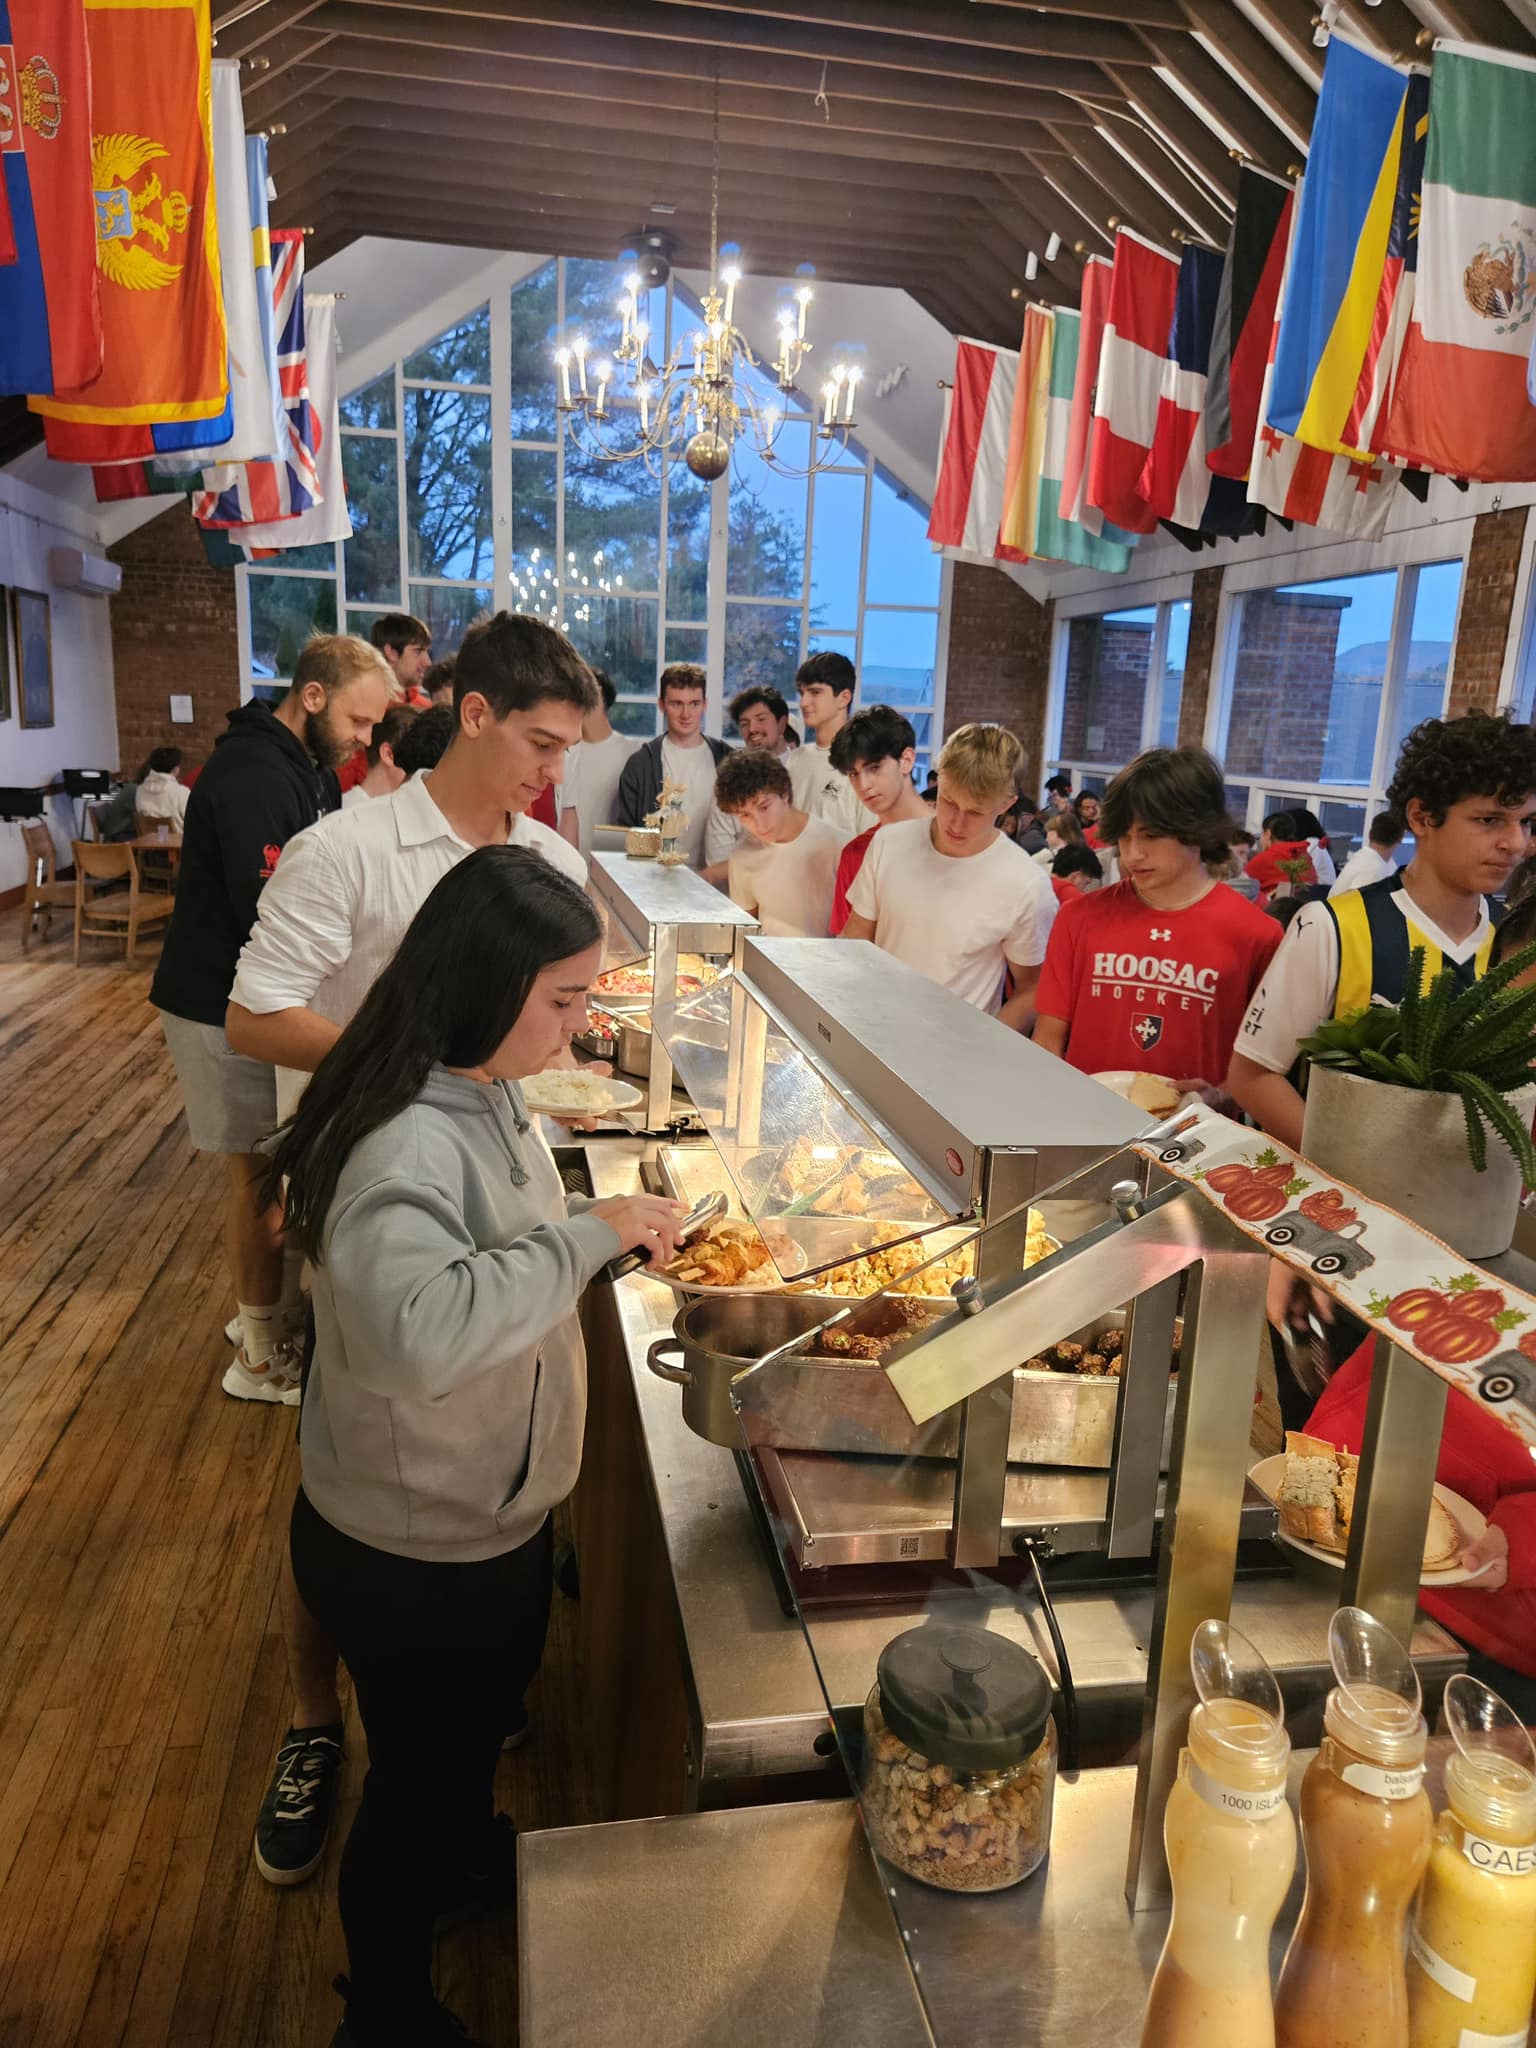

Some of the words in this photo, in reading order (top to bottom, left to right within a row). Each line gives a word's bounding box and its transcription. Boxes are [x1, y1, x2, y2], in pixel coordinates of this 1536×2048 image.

[1092, 952, 1219, 994] HOOSAC
[1091, 983, 1213, 1015] HOCKEY
[1221, 1793, 1253, 1810] 1000
